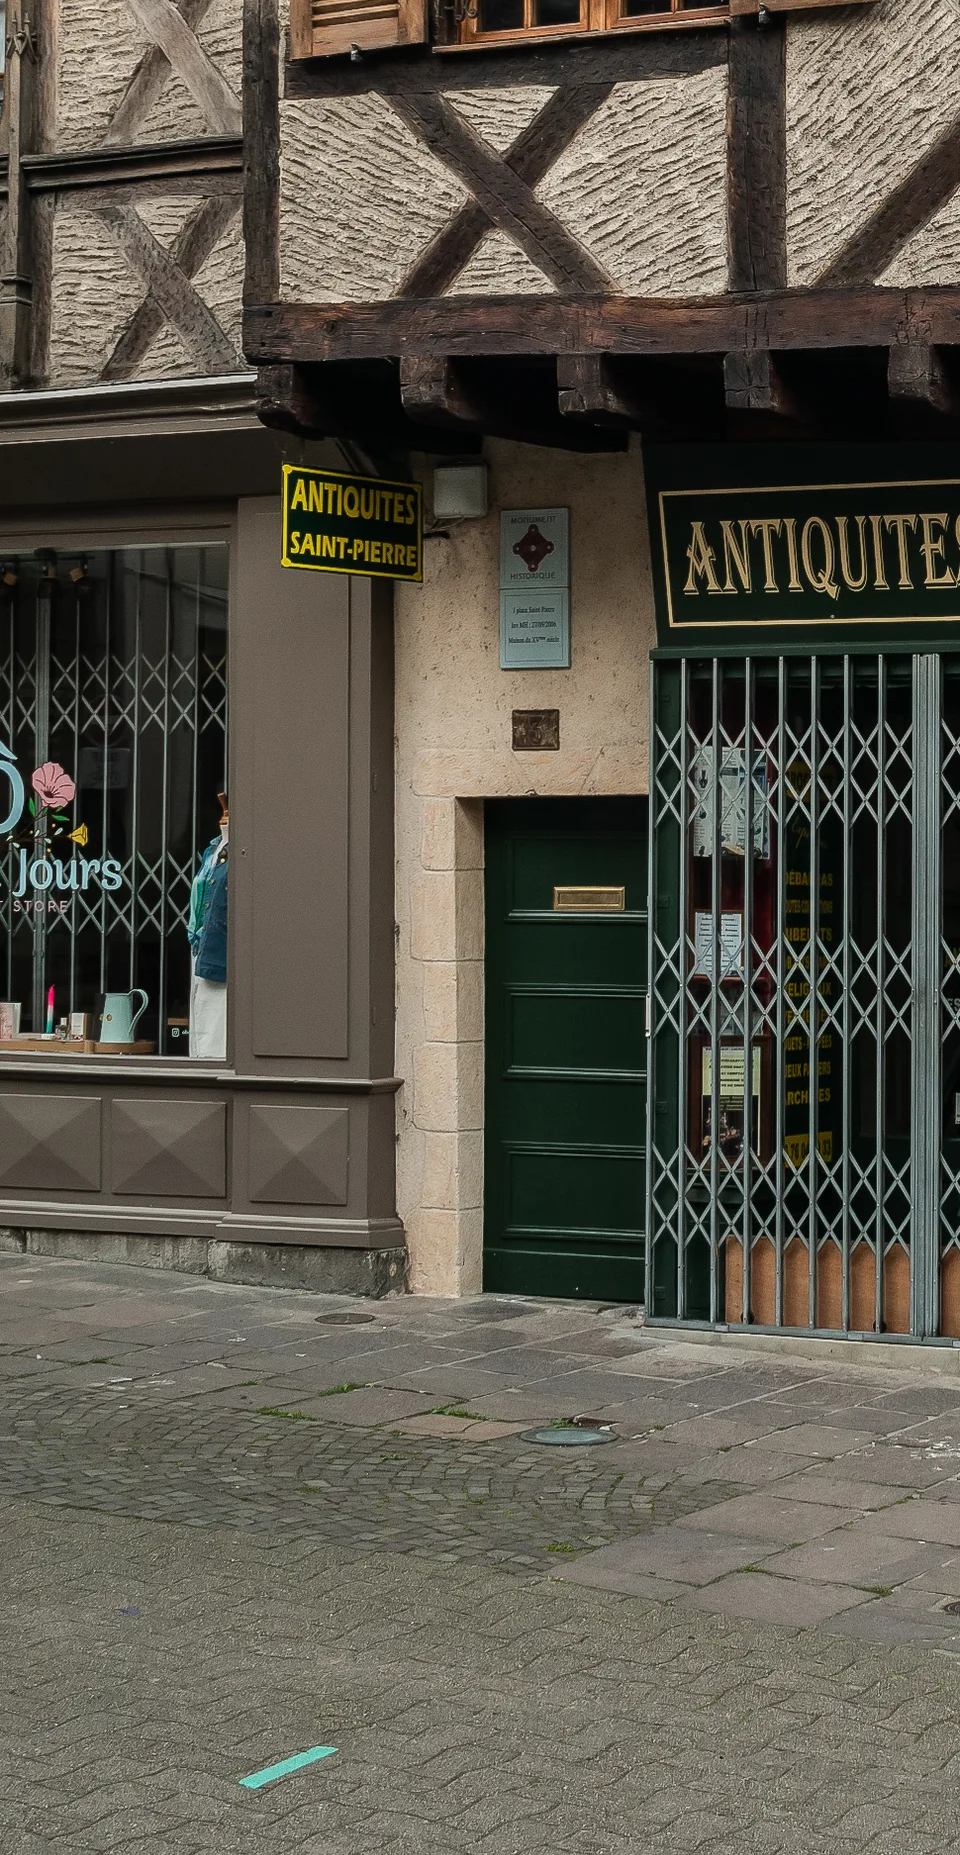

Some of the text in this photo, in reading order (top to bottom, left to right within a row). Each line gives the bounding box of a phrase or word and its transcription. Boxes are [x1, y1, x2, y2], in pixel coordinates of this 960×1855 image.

[290, 478, 415, 525] ANTIQUITES
[510, 516, 557, 524] MONUMENT
[290, 531, 417, 567] SAINT-PIERRE
[510, 571, 556, 581] HISTORIQUE
[12, 848, 123, 897] Jours
[13, 900, 69, 913] STORE
